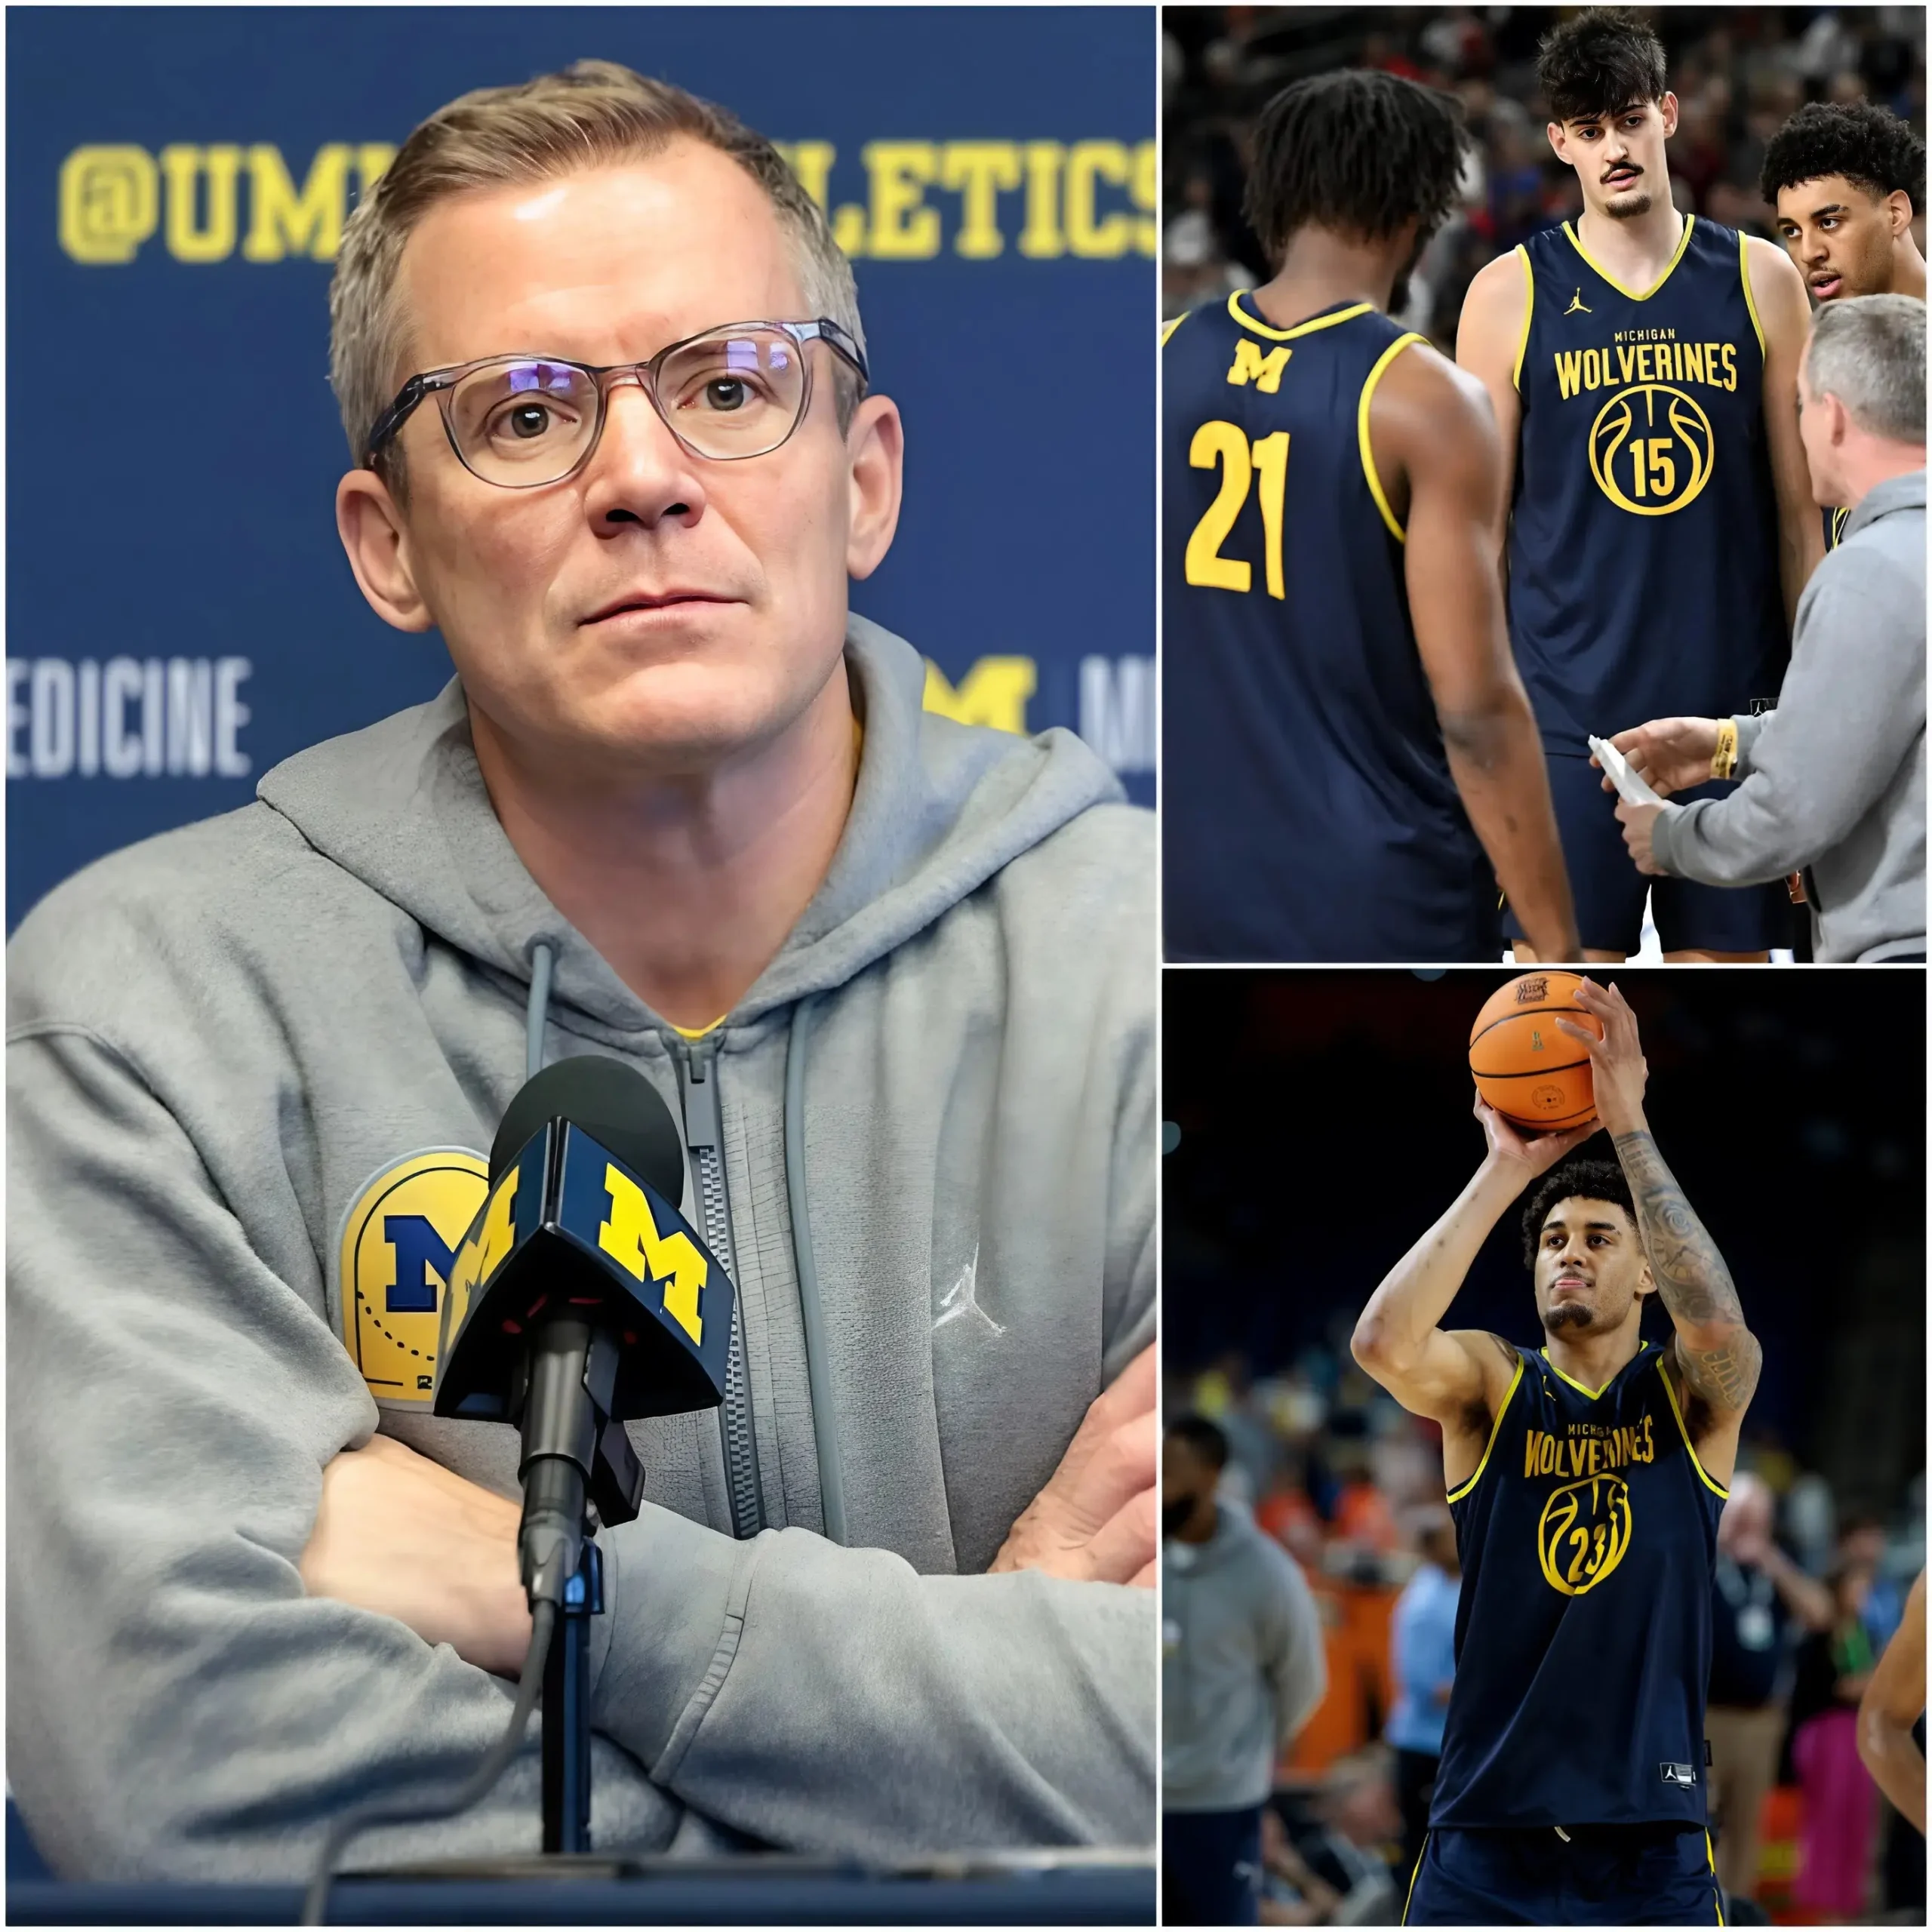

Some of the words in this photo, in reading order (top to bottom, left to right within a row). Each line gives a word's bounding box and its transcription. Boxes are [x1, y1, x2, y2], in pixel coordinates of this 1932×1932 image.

[58, 141, 397, 264] @UM
[771, 139, 1156, 260] LETIC
[1226, 337, 1294, 394] M
[1614, 328, 1676, 343] MICHIGAN
[1553, 342, 1738, 401] WOLVERINES
[1629, 437, 1676, 497] 15
[1184, 420, 1291, 601] 21
[598, 1161, 709, 1347] M
[1567, 1522, 1607, 1583] 23
